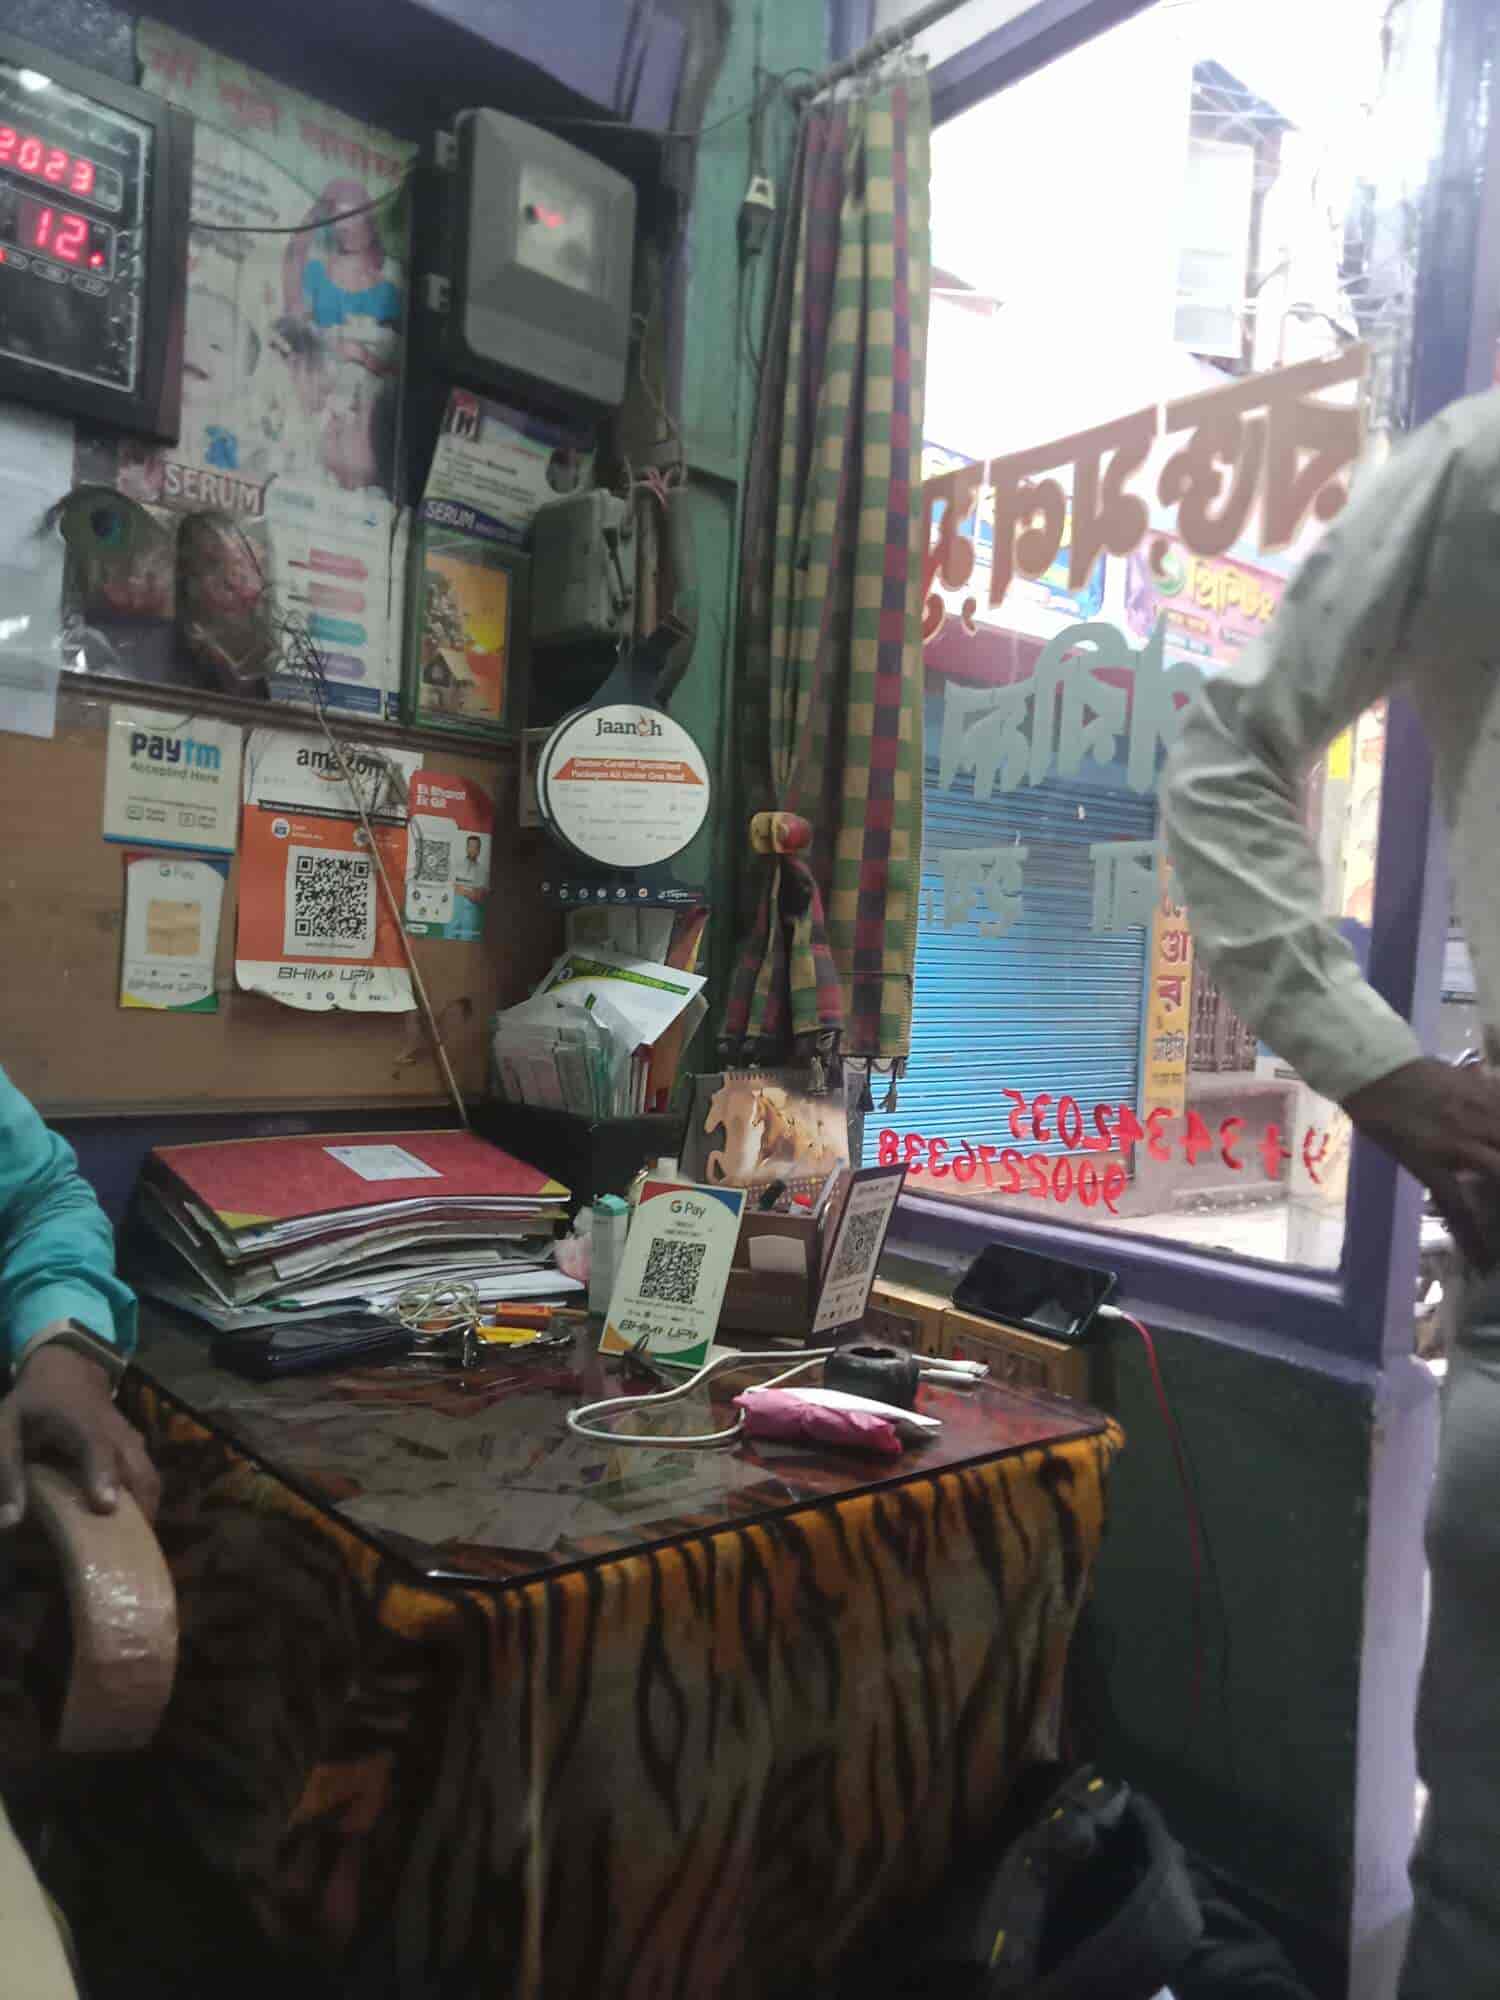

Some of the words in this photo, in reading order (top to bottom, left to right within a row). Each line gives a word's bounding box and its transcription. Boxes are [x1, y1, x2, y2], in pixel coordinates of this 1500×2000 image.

[0, 127, 95, 195] 2023
[36, 207, 88, 261] 12
[165, 466, 263, 514] SERUM
[595, 714, 662, 736] Jaanch
[130, 733, 222, 768] paytm
